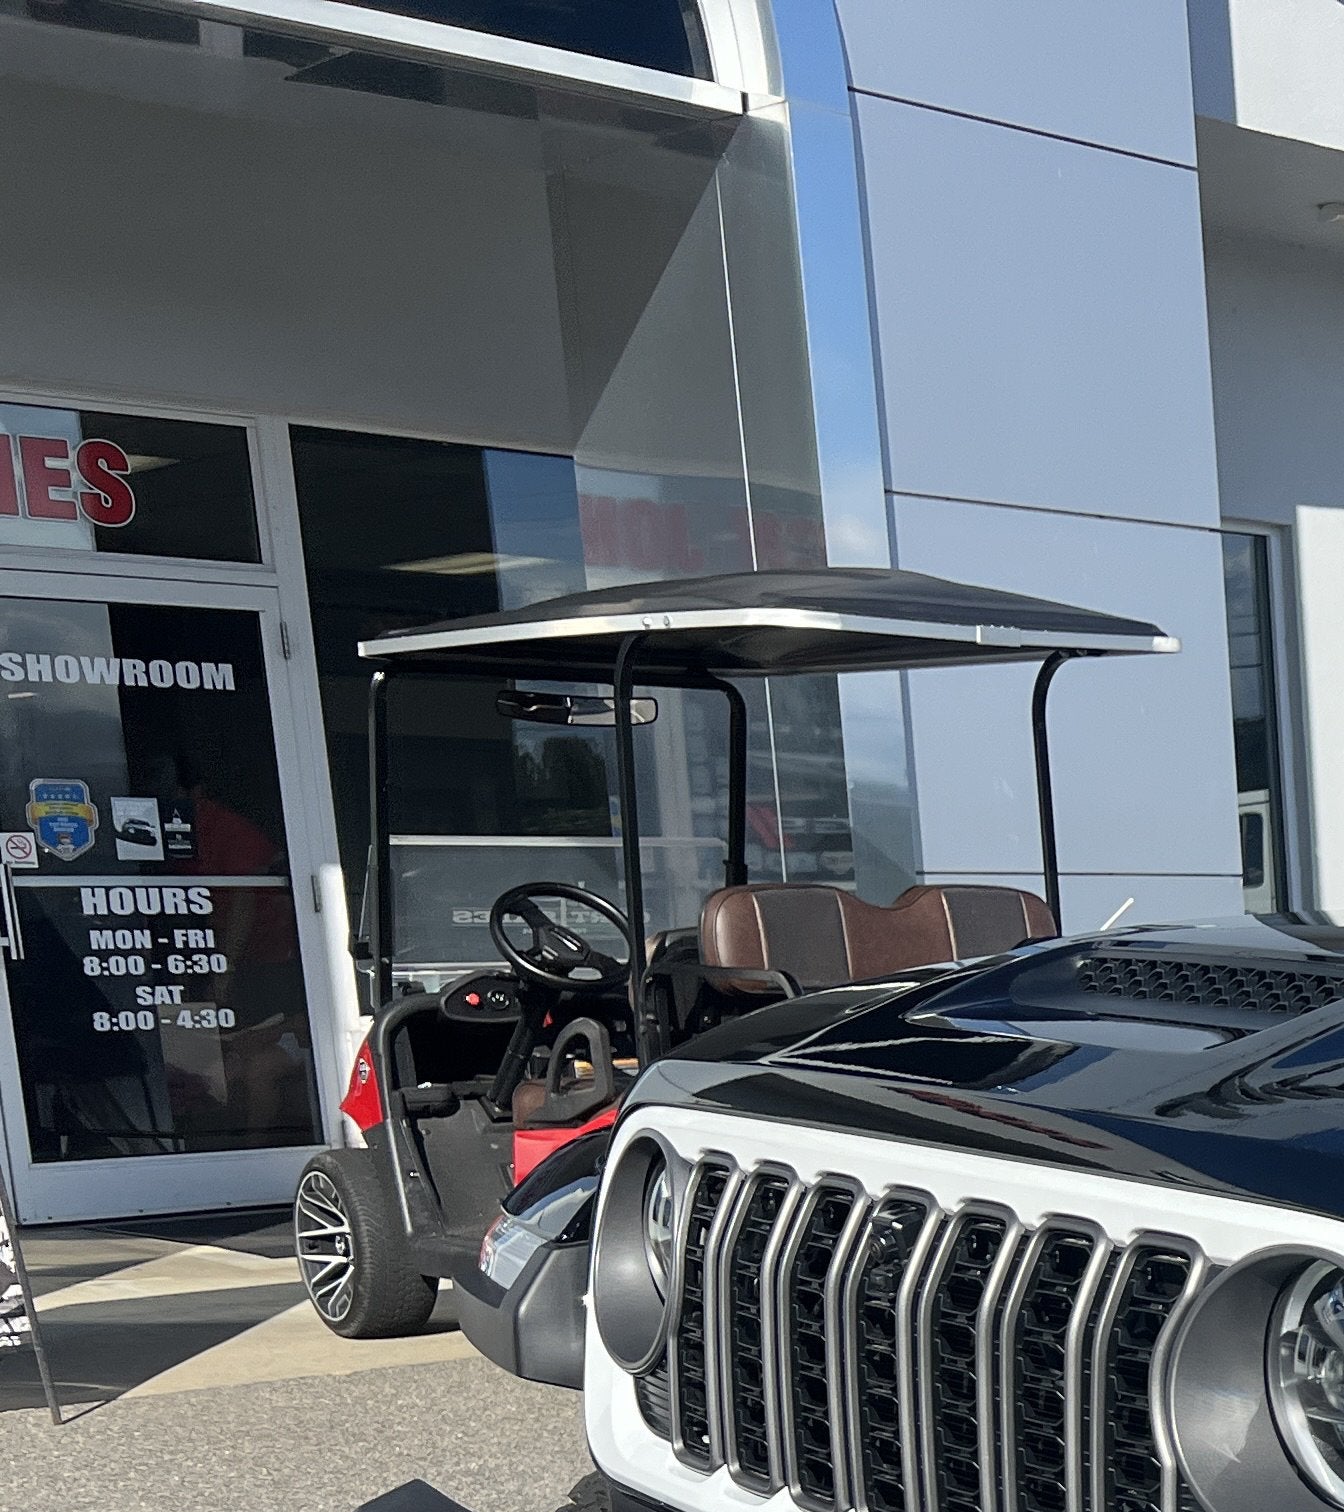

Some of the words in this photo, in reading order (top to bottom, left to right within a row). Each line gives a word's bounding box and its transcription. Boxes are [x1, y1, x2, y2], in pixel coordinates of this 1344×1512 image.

[0, 652, 236, 691] SHOWROOM
[80, 886, 213, 916] HOURS
[89, 929, 152, 950] MON
[173, 929, 215, 949] FRI
[83, 955, 146, 976] 8:00
[167, 953, 228, 975] 6:30
[135, 985, 184, 1006] SAT
[93, 1010, 155, 1032] 8:00
[177, 1008, 236, 1030] 4:30
